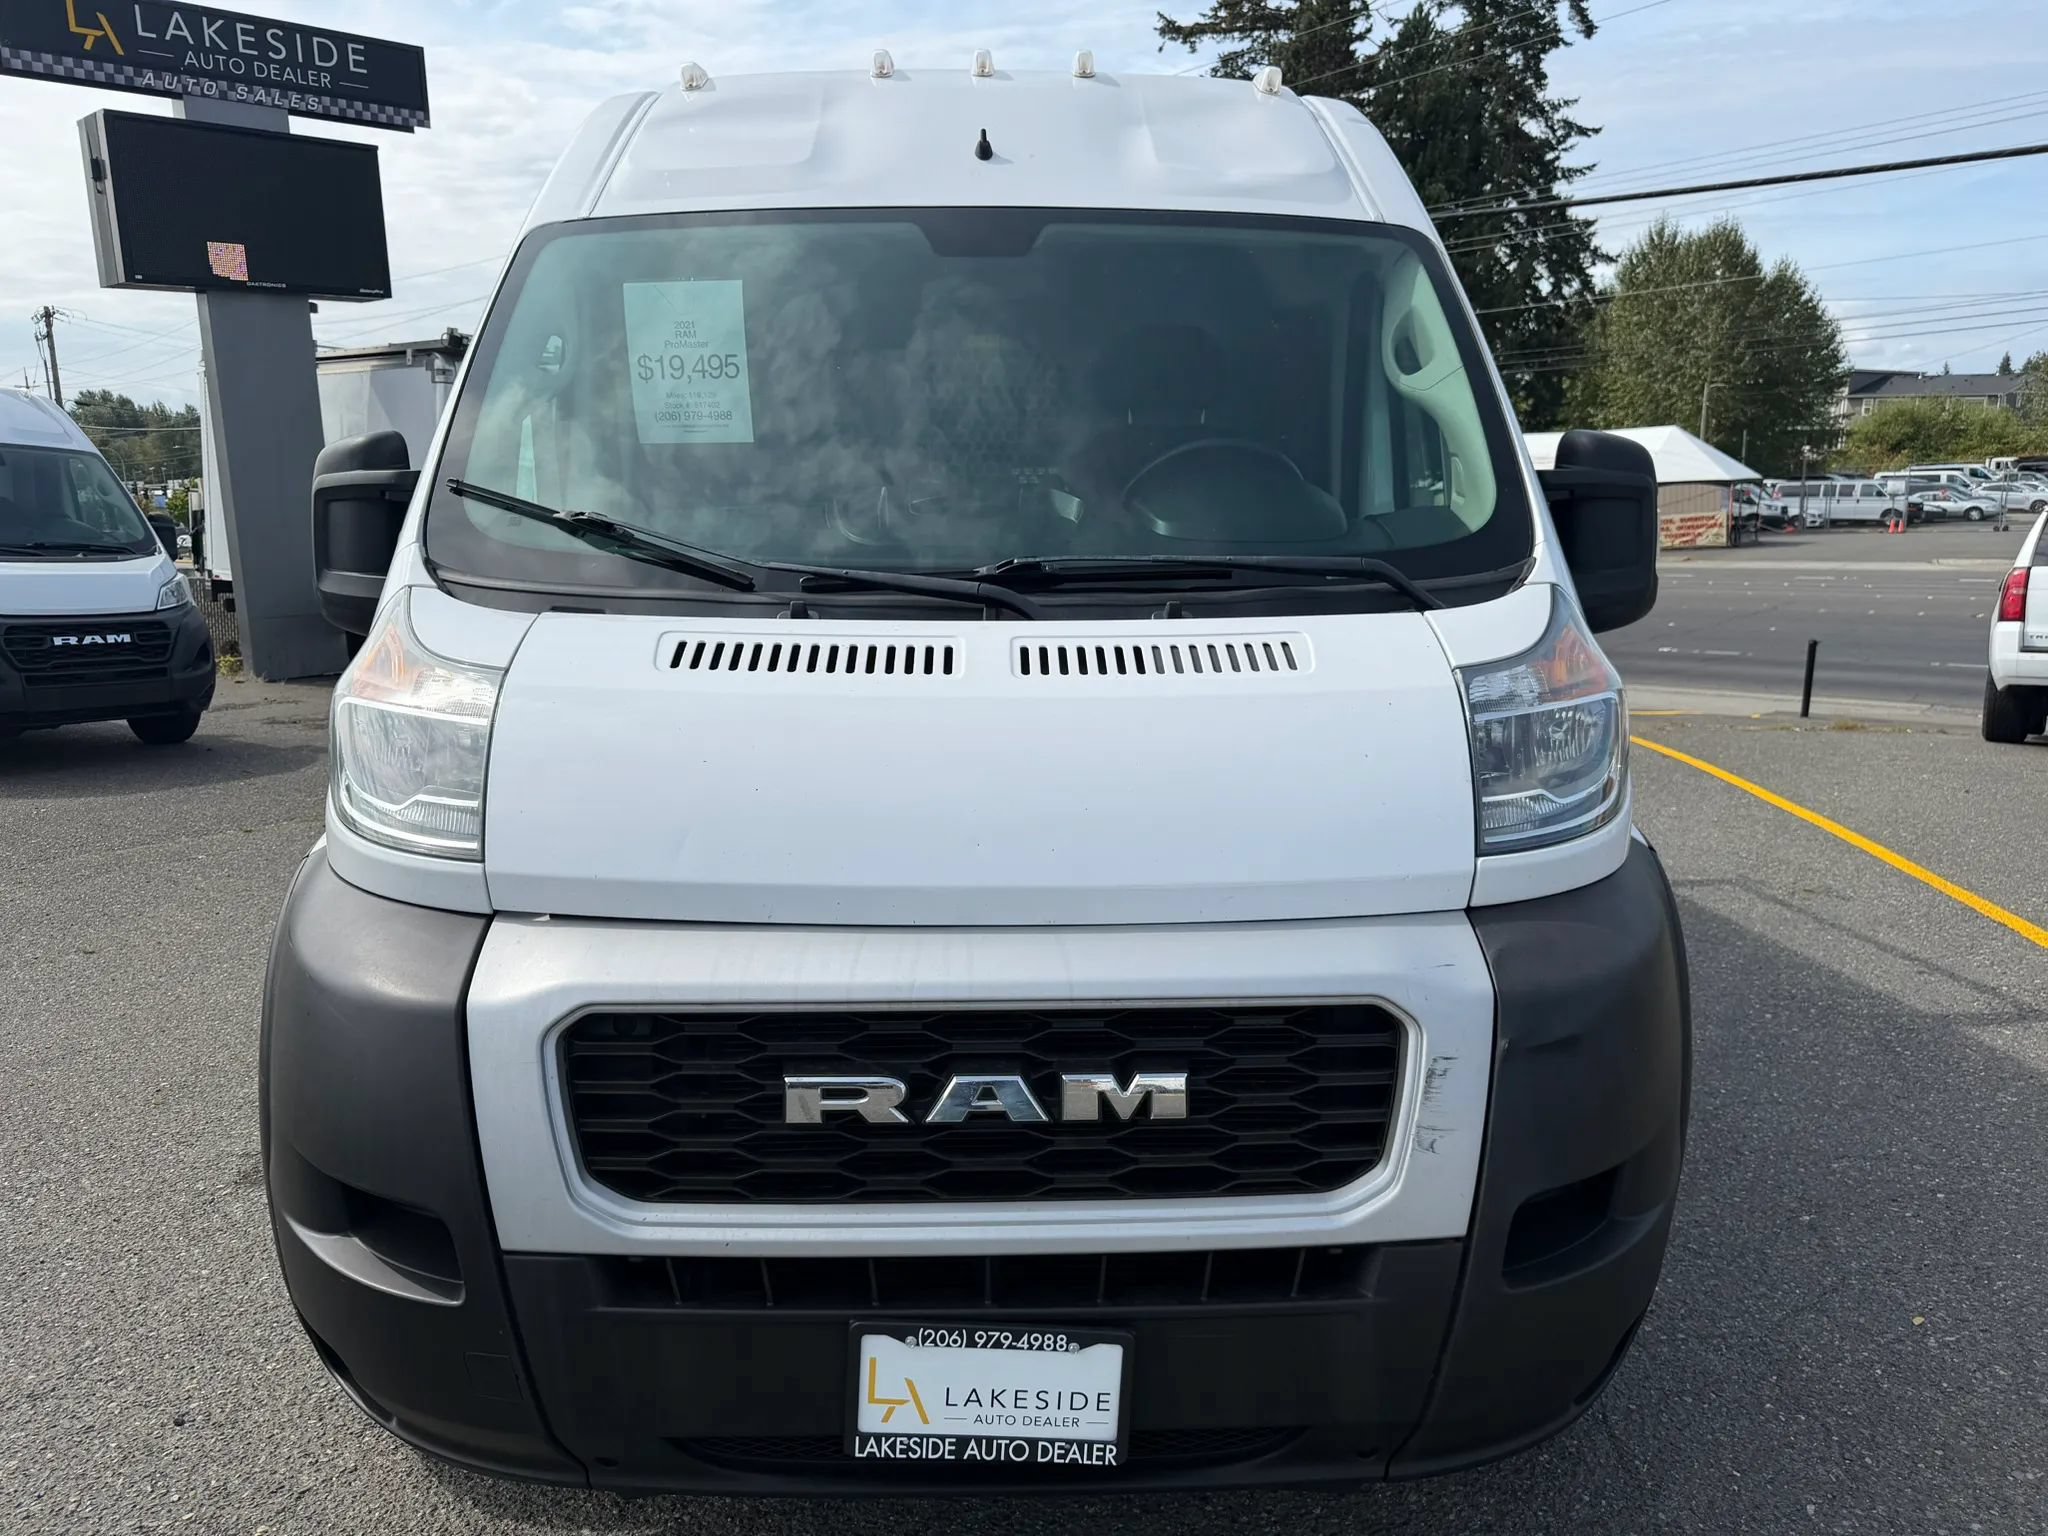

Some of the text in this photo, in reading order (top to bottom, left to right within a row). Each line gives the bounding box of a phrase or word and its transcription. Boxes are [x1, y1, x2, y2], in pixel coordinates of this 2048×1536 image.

[134, 4, 368, 74] LAKESIDE
[184, 50, 332, 88] AUTO DEALER
[142, 72, 320, 111] AUTO SALES
[674, 320, 696, 329] 2021
[675, 330, 697, 339] RAM
[664, 340, 709, 349] ProMaster
[637, 353, 740, 384] $19,495
[655, 410, 733, 423] (206) 979-4988
[53, 633, 132, 646] RAM
[784, 1072, 1189, 1124] RAM
[918, 1327, 1068, 1352] (206) 979-4988
[945, 1387, 1112, 1412] LAKESIDE
[973, 1414, 1080, 1428] AUTO DEALER
[854, 1436, 1117, 1466] LAKESIDE AUTO DEALER
